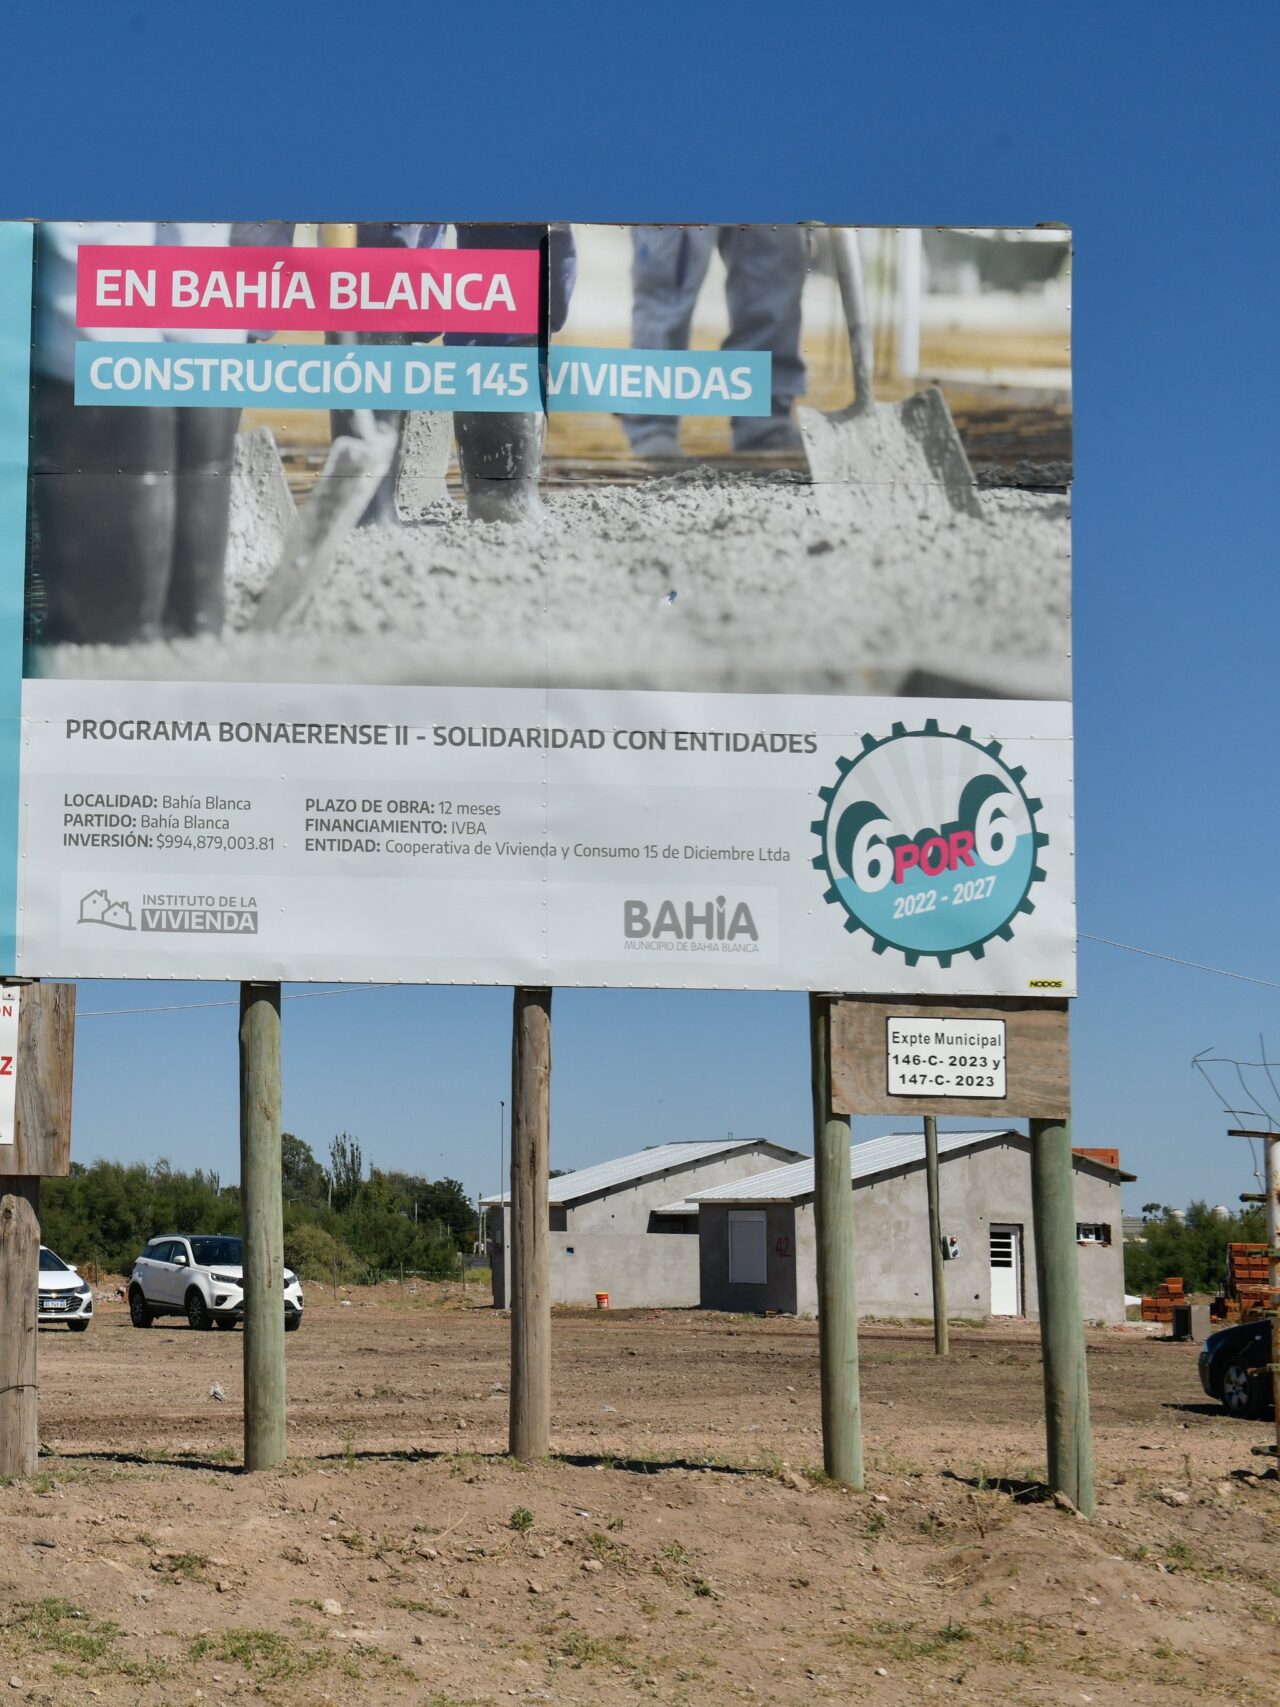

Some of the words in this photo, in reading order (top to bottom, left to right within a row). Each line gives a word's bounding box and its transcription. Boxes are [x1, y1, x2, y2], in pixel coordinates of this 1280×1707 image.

[96, 269, 156, 307] EN
[171, 261, 316, 310] BAHÍA
[328, 271, 517, 312] BLANCA
[88, 352, 392, 395] CONSTRUCCIÓN
[404, 361, 457, 395] DE
[466, 361, 529, 397] 145
[548, 363, 752, 400] VIVIENDAS
[65, 719, 212, 742] PROGRAMA
[218, 722, 390, 745] BONAERENSE
[395, 724, 409, 746] II
[432, 725, 606, 749] SOLIDARIDAD
[612, 728, 667, 751] CON
[673, 730, 819, 754] ENTIDADES
[63, 793, 159, 810] LOCALIDAD:
[161, 795, 202, 811] Bahía
[206, 796, 251, 812] Blanca
[305, 798, 359, 815] PLAZO
[362, 800, 383, 815] DE
[387, 800, 436, 817] OBRA:
[438, 802, 453, 816] 12
[456, 805, 501, 817] meses
[63, 813, 137, 829] PARTIDO:
[139, 814, 181, 830] Bahía
[183, 814, 231, 831] Blanca
[305, 819, 448, 837] FINANCIAMIENTO:
[451, 821, 488, 837] IVBA
[62, 832, 154, 850] INVERSIÓN:
[155, 833, 275, 853] $994,879,003.81
[304, 838, 382, 854] ENTIDAD:
[384, 839, 470, 858] Cooperativa
[473, 841, 490, 856] de
[494, 841, 557, 858] Vivienda
[560, 846, 570, 861] y
[572, 844, 639, 860] Consumo
[643, 845, 659, 860] 15
[661, 845, 680, 861] de
[683, 845, 755, 862] Diciembre
[757, 846, 791, 862] Ltda
[141, 894, 216, 908] INSTITUTO
[218, 895, 237, 908] DE
[239, 895, 258, 908] LA
[893, 890, 936, 919] 2022
[952, 875, 996, 906] 2027
[144, 911, 255, 932] VIVIENDA
[624, 940, 674, 951] MUNICIPIO
[676, 941, 689, 952] DE
[722, 942, 759, 953] BLANCA
[1030, 980, 1062, 988] NODOS
[892, 1031, 931, 1047] Expte
[934, 1032, 1001, 1049] Municipal
[948, 1056, 988, 1068] 2023
[992, 1059, 1000, 1070] y
[955, 1075, 995, 1087] 2023
[776, 1236, 791, 1257] 42
